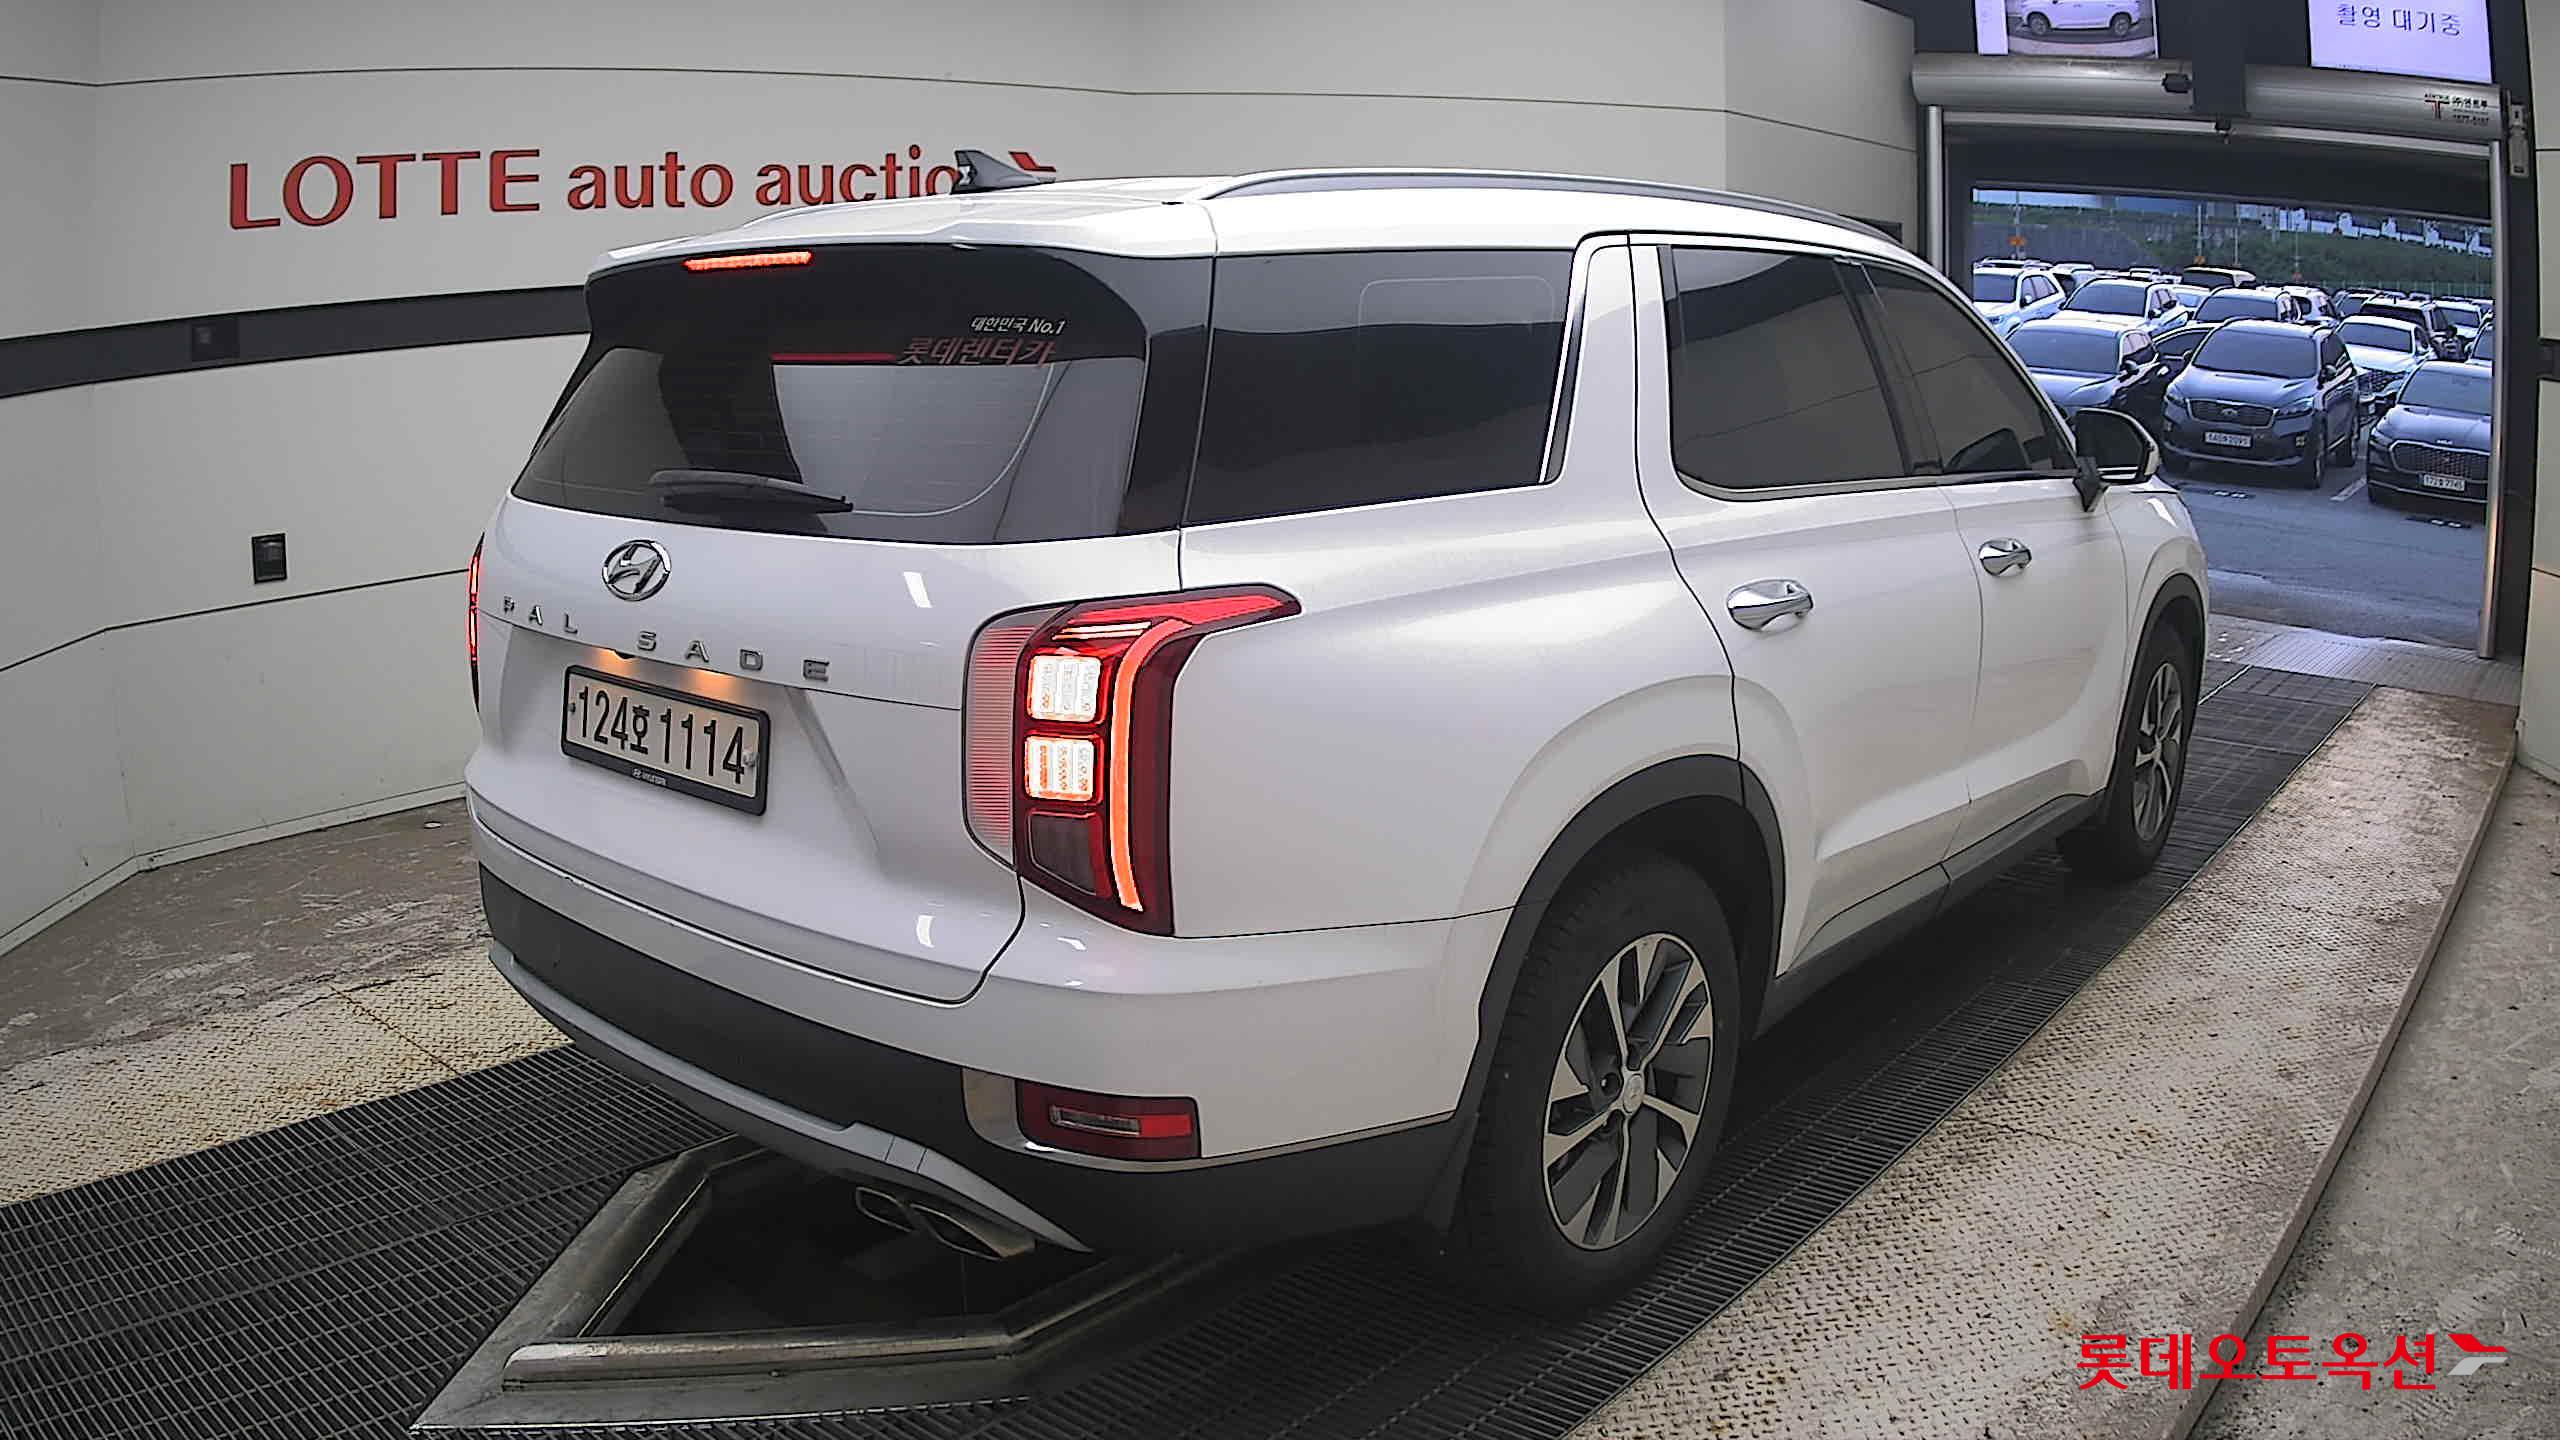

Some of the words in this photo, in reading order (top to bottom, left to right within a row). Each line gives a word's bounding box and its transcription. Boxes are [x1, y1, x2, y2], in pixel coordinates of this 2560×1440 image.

[2392, 8, 2461, 37] 대기중
[229, 148, 541, 231] LOTTE
[567, 151, 736, 209] auto
[755, 144, 961, 206] auctio
[970, 315, 1029, 333] 대한민국
[1028, 317, 1066, 335] No.1
[898, 336, 1057, 367] 롯데렌터카
